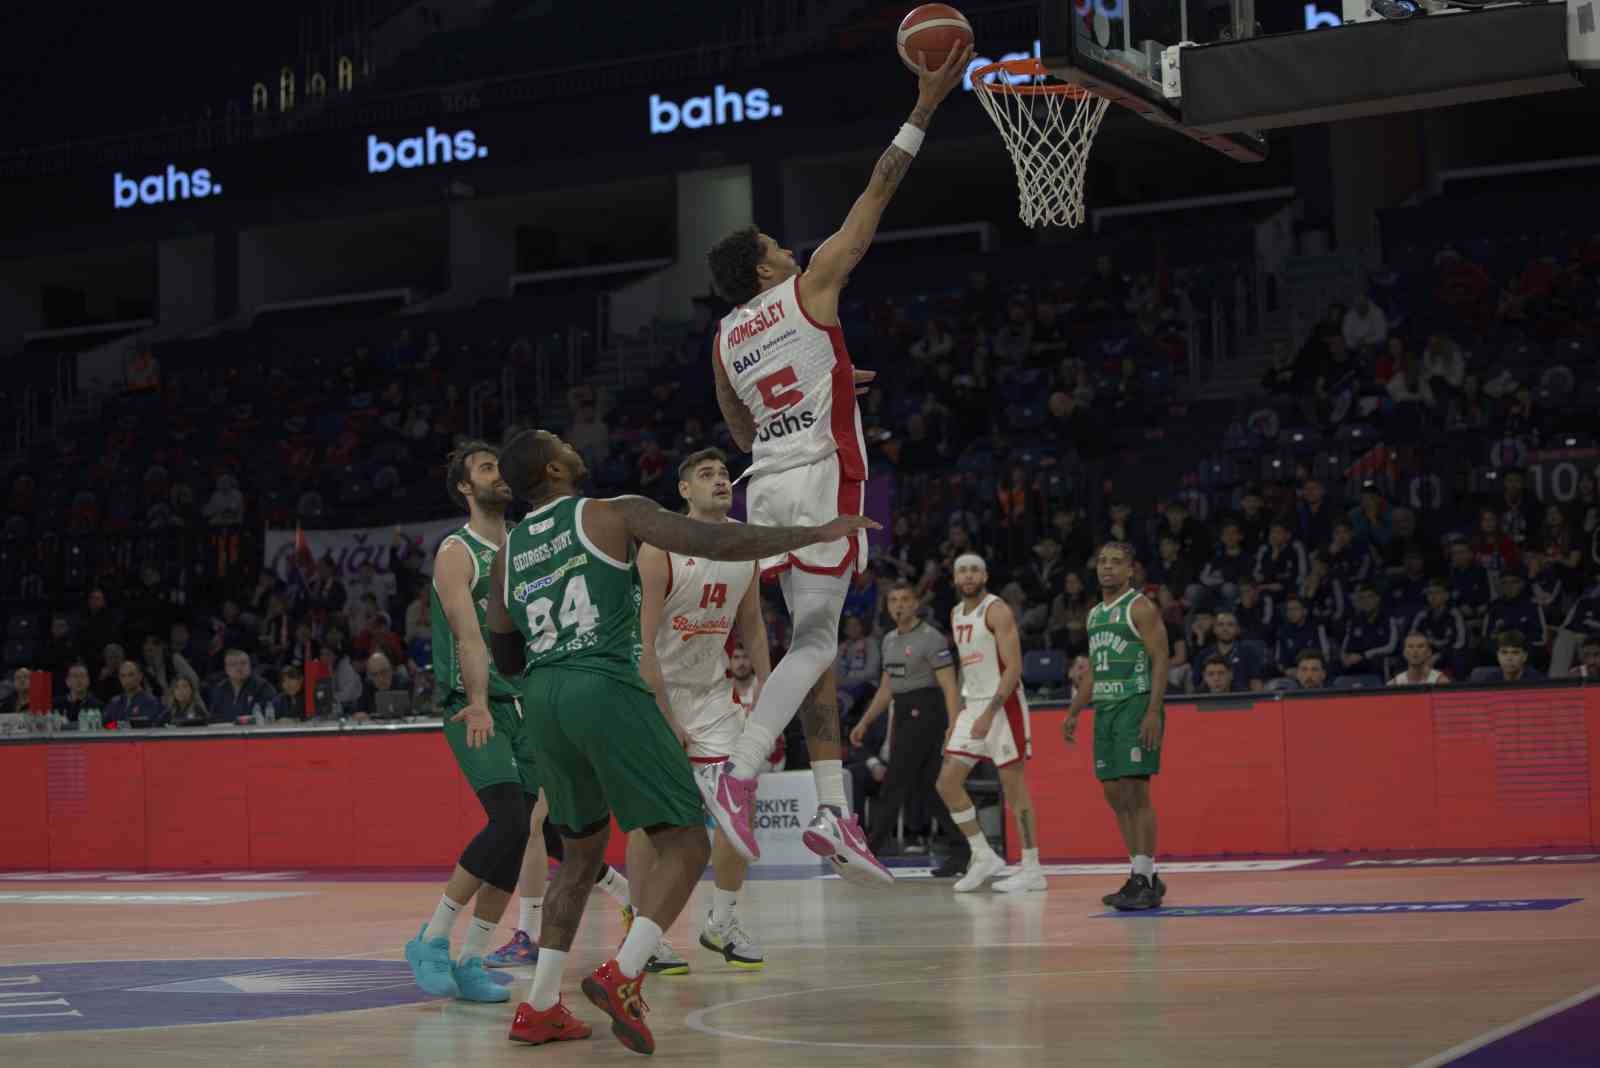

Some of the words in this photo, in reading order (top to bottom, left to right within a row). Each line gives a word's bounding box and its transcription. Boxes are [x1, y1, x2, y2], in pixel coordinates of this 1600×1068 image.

[647, 84, 783, 135] bahs.
[366, 126, 489, 174] bahs.
[113, 163, 223, 209] bahs.
[727, 300, 786, 349] HOMESLEY
[733, 349, 762, 375] BAU
[756, 366, 804, 411] 5
[525, 574, 601, 654] 94
[699, 583, 728, 608] 14
[956, 624, 974, 644] 77
